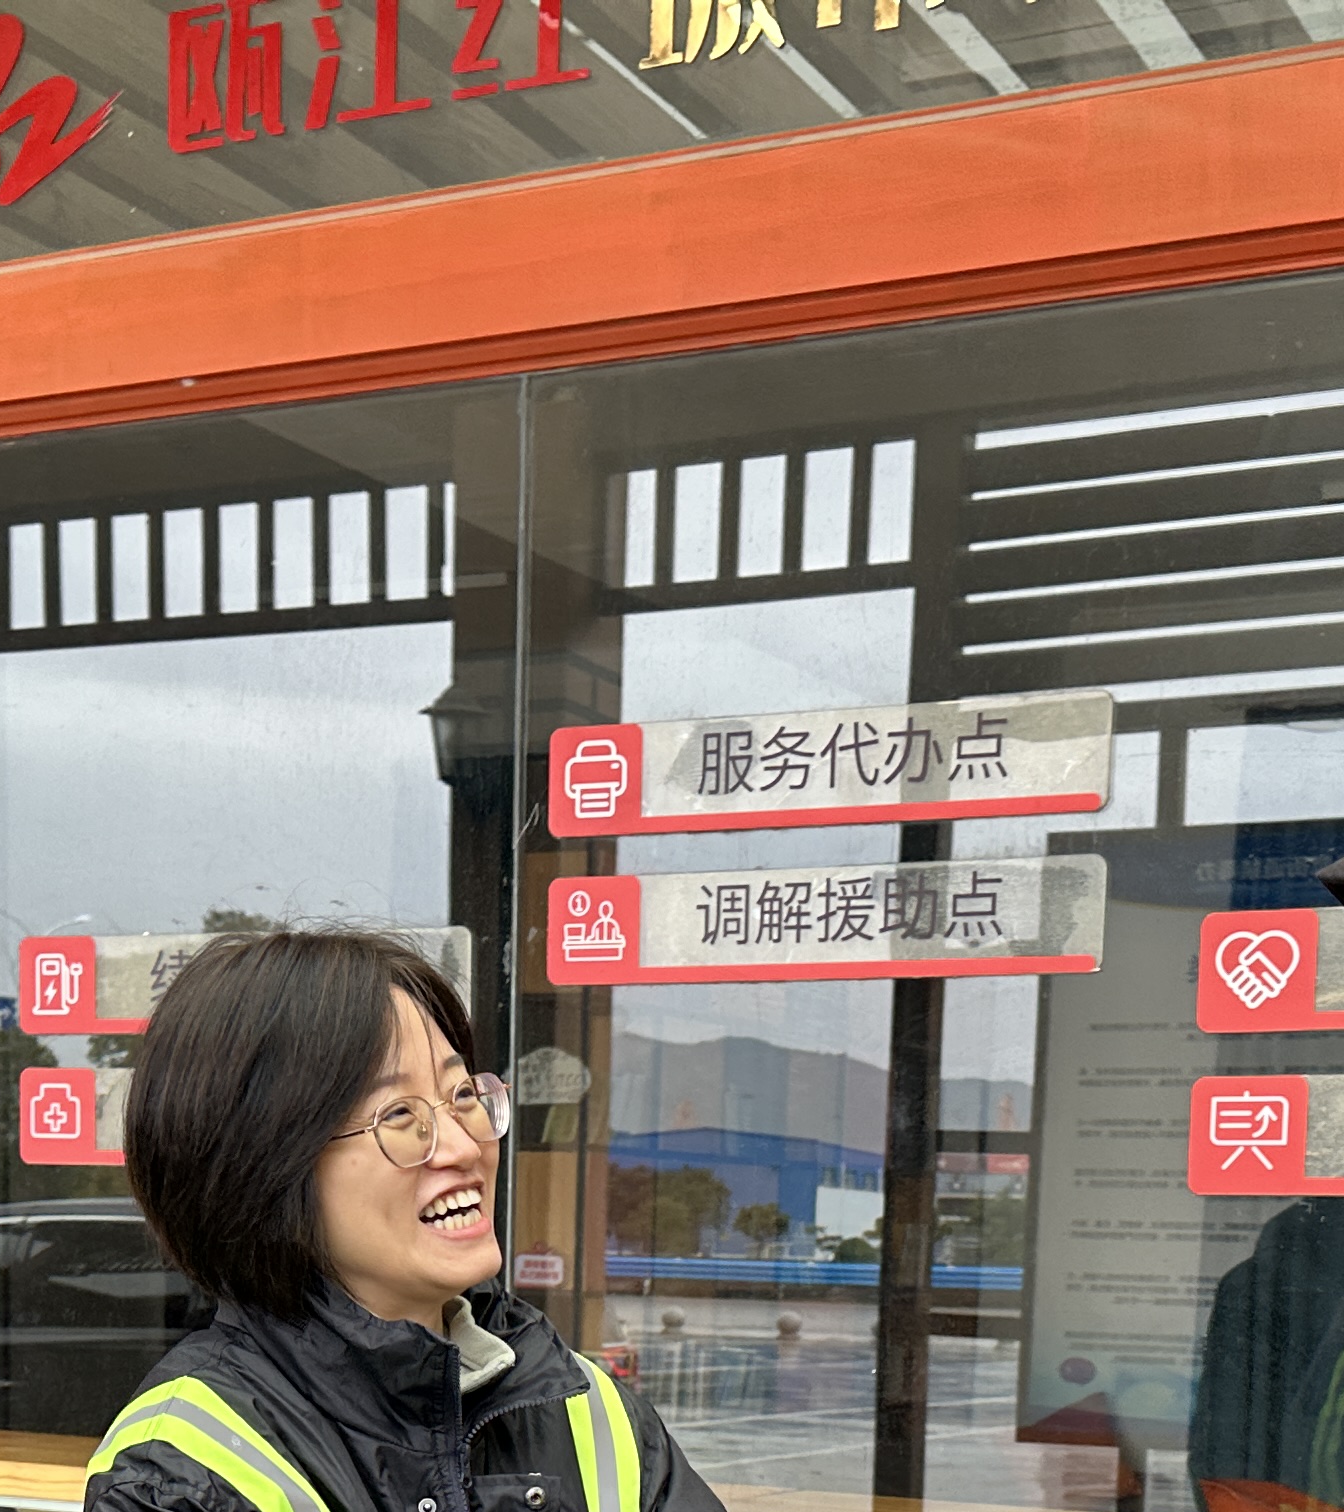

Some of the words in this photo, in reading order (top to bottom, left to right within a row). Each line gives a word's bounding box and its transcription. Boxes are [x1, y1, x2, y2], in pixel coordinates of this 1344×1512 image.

[697, 711, 1009, 796] 服务代办点
[696, 870, 1004, 947] 调解援助点
